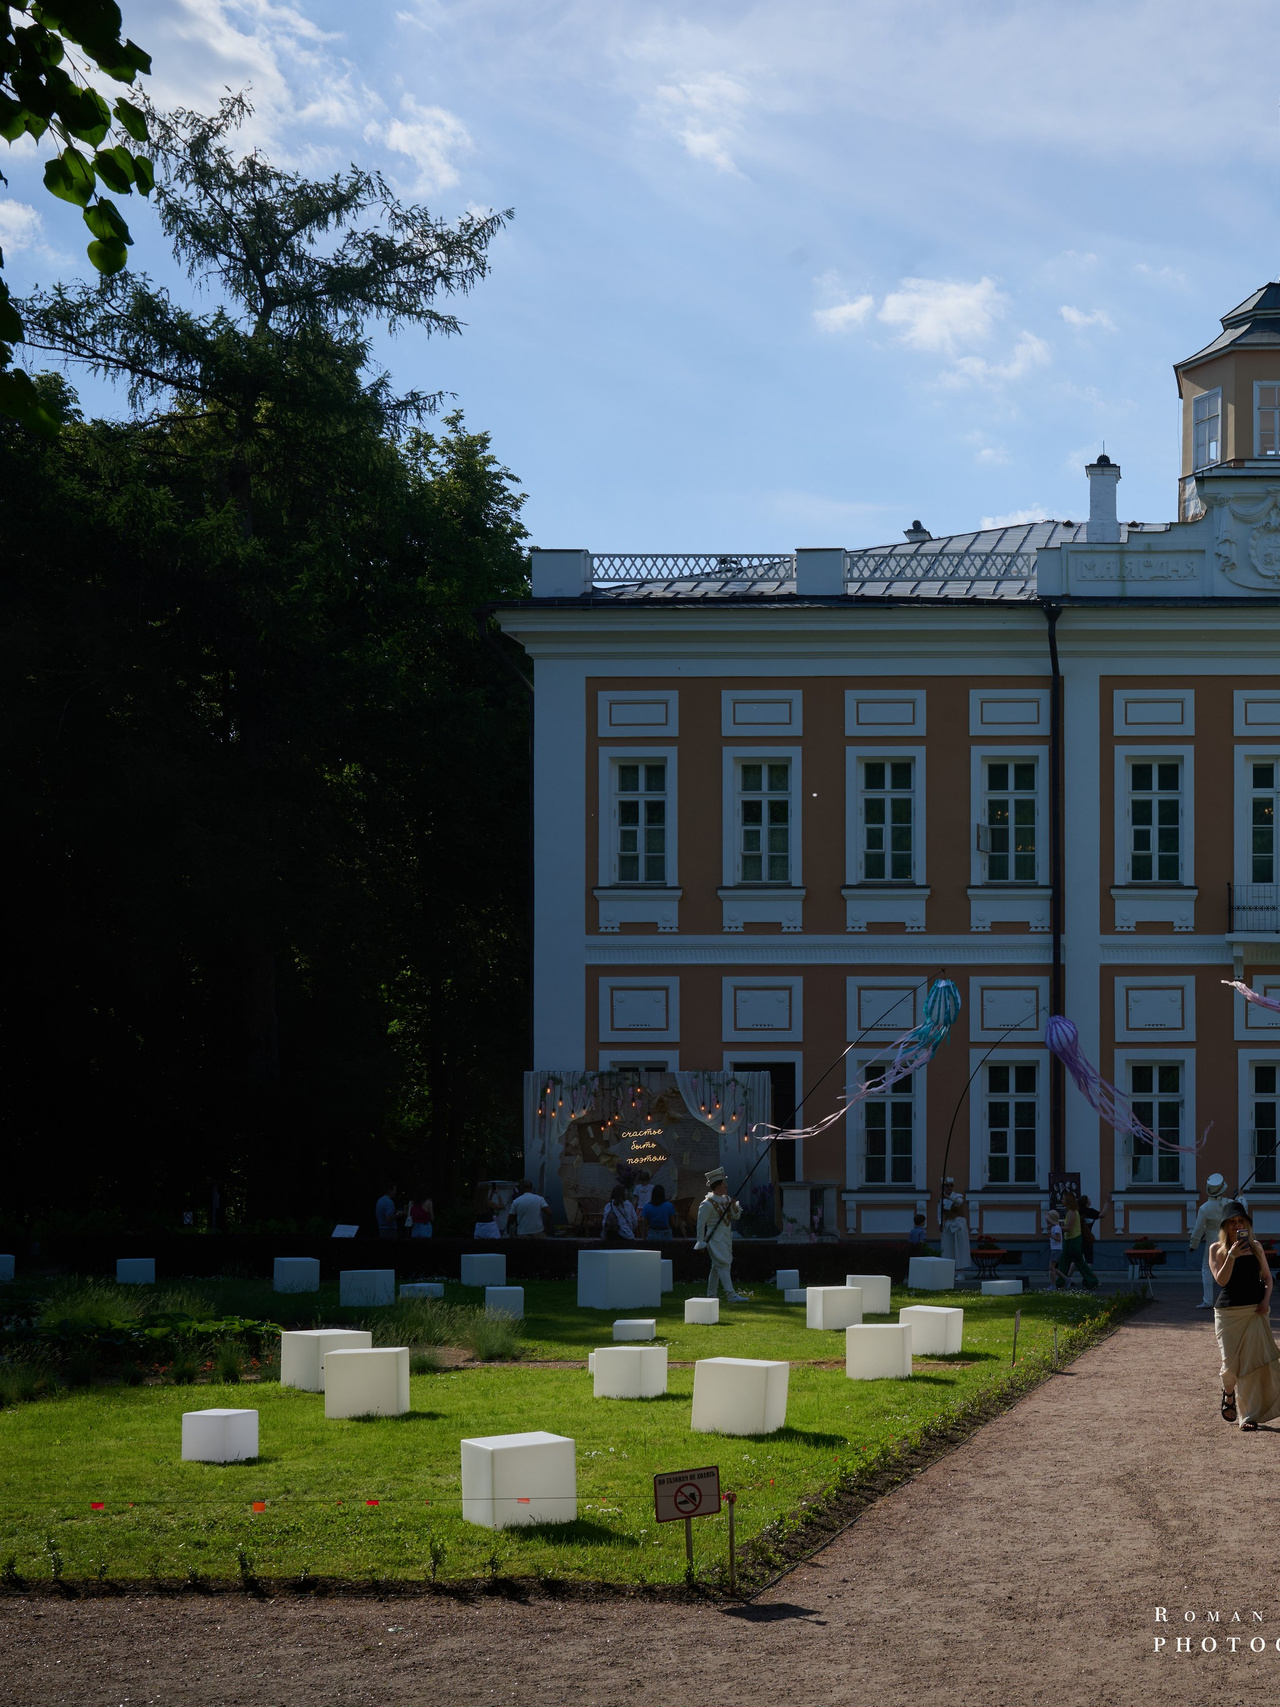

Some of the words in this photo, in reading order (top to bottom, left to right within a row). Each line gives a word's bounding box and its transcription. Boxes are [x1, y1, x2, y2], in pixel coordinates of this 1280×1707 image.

[1150, 559, 1197, 579] ДНЯ
[621, 1127, 664, 1138] счастье
[630, 1139, 657, 1151] быть
[626, 1154, 668, 1165] поэтом
